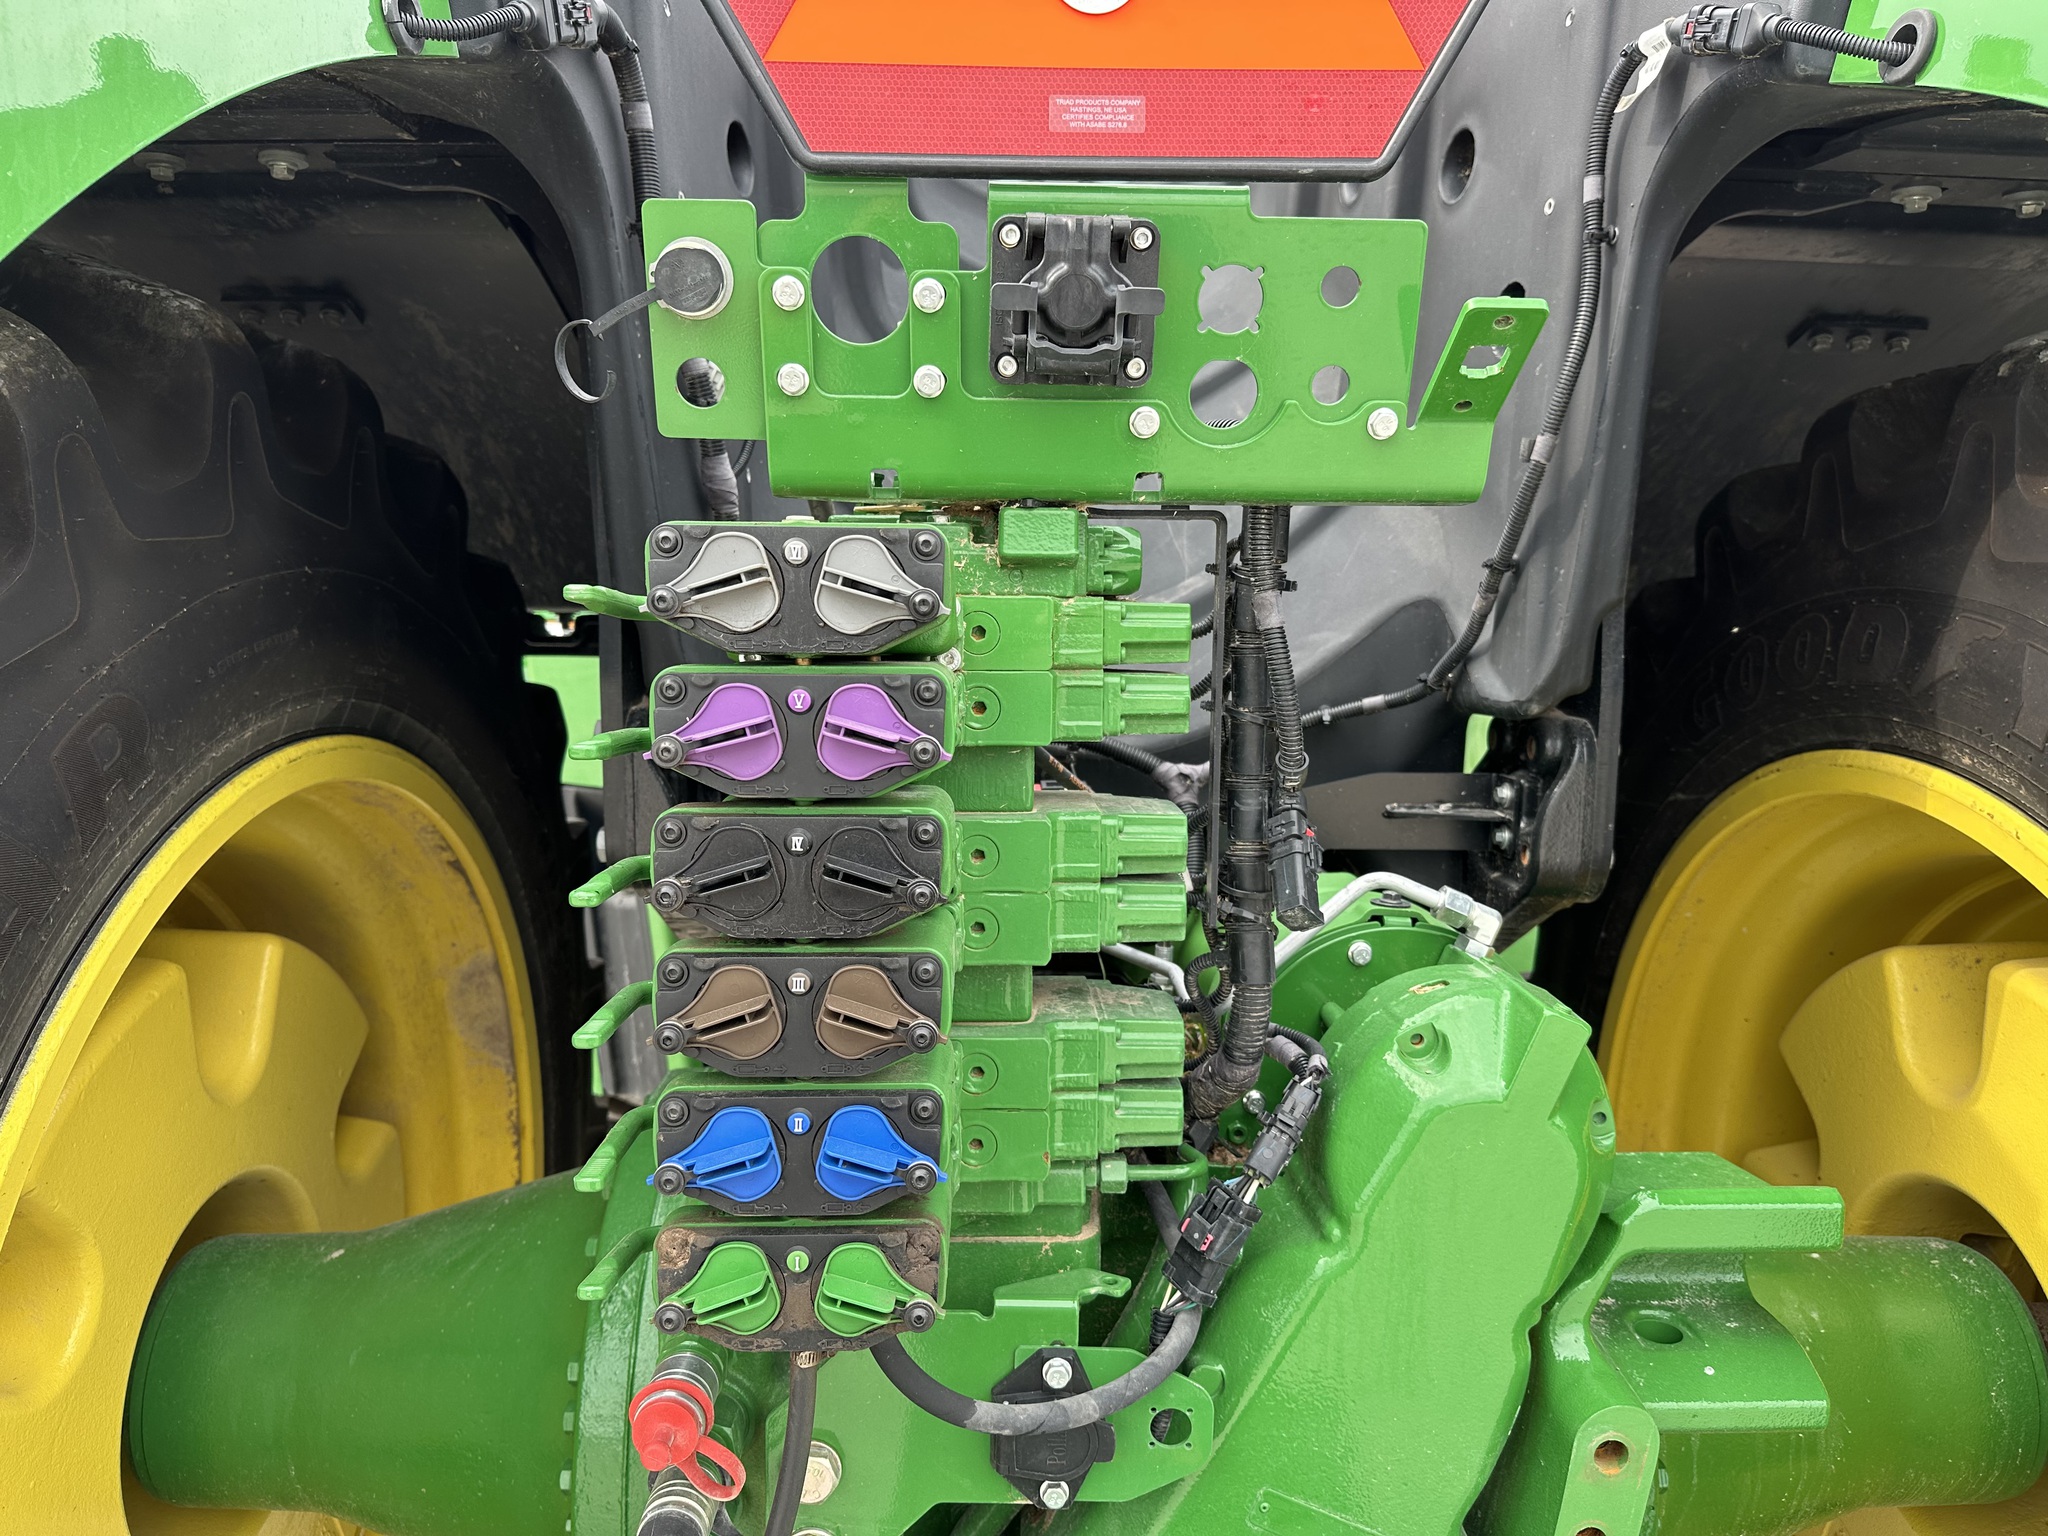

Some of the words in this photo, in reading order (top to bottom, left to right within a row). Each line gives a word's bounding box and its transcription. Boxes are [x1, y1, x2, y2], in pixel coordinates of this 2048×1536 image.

[1056, 98, 1075, 106] TRIAD
[1075, 98, 1109, 106] PRODUCTS
[789, 544, 803, 560] VI
[792, 693, 806, 709] V
[790, 836, 804, 851] IV
[791, 977, 806, 992] III
[793, 1117, 804, 1133] II
[794, 1256, 801, 1271] I
